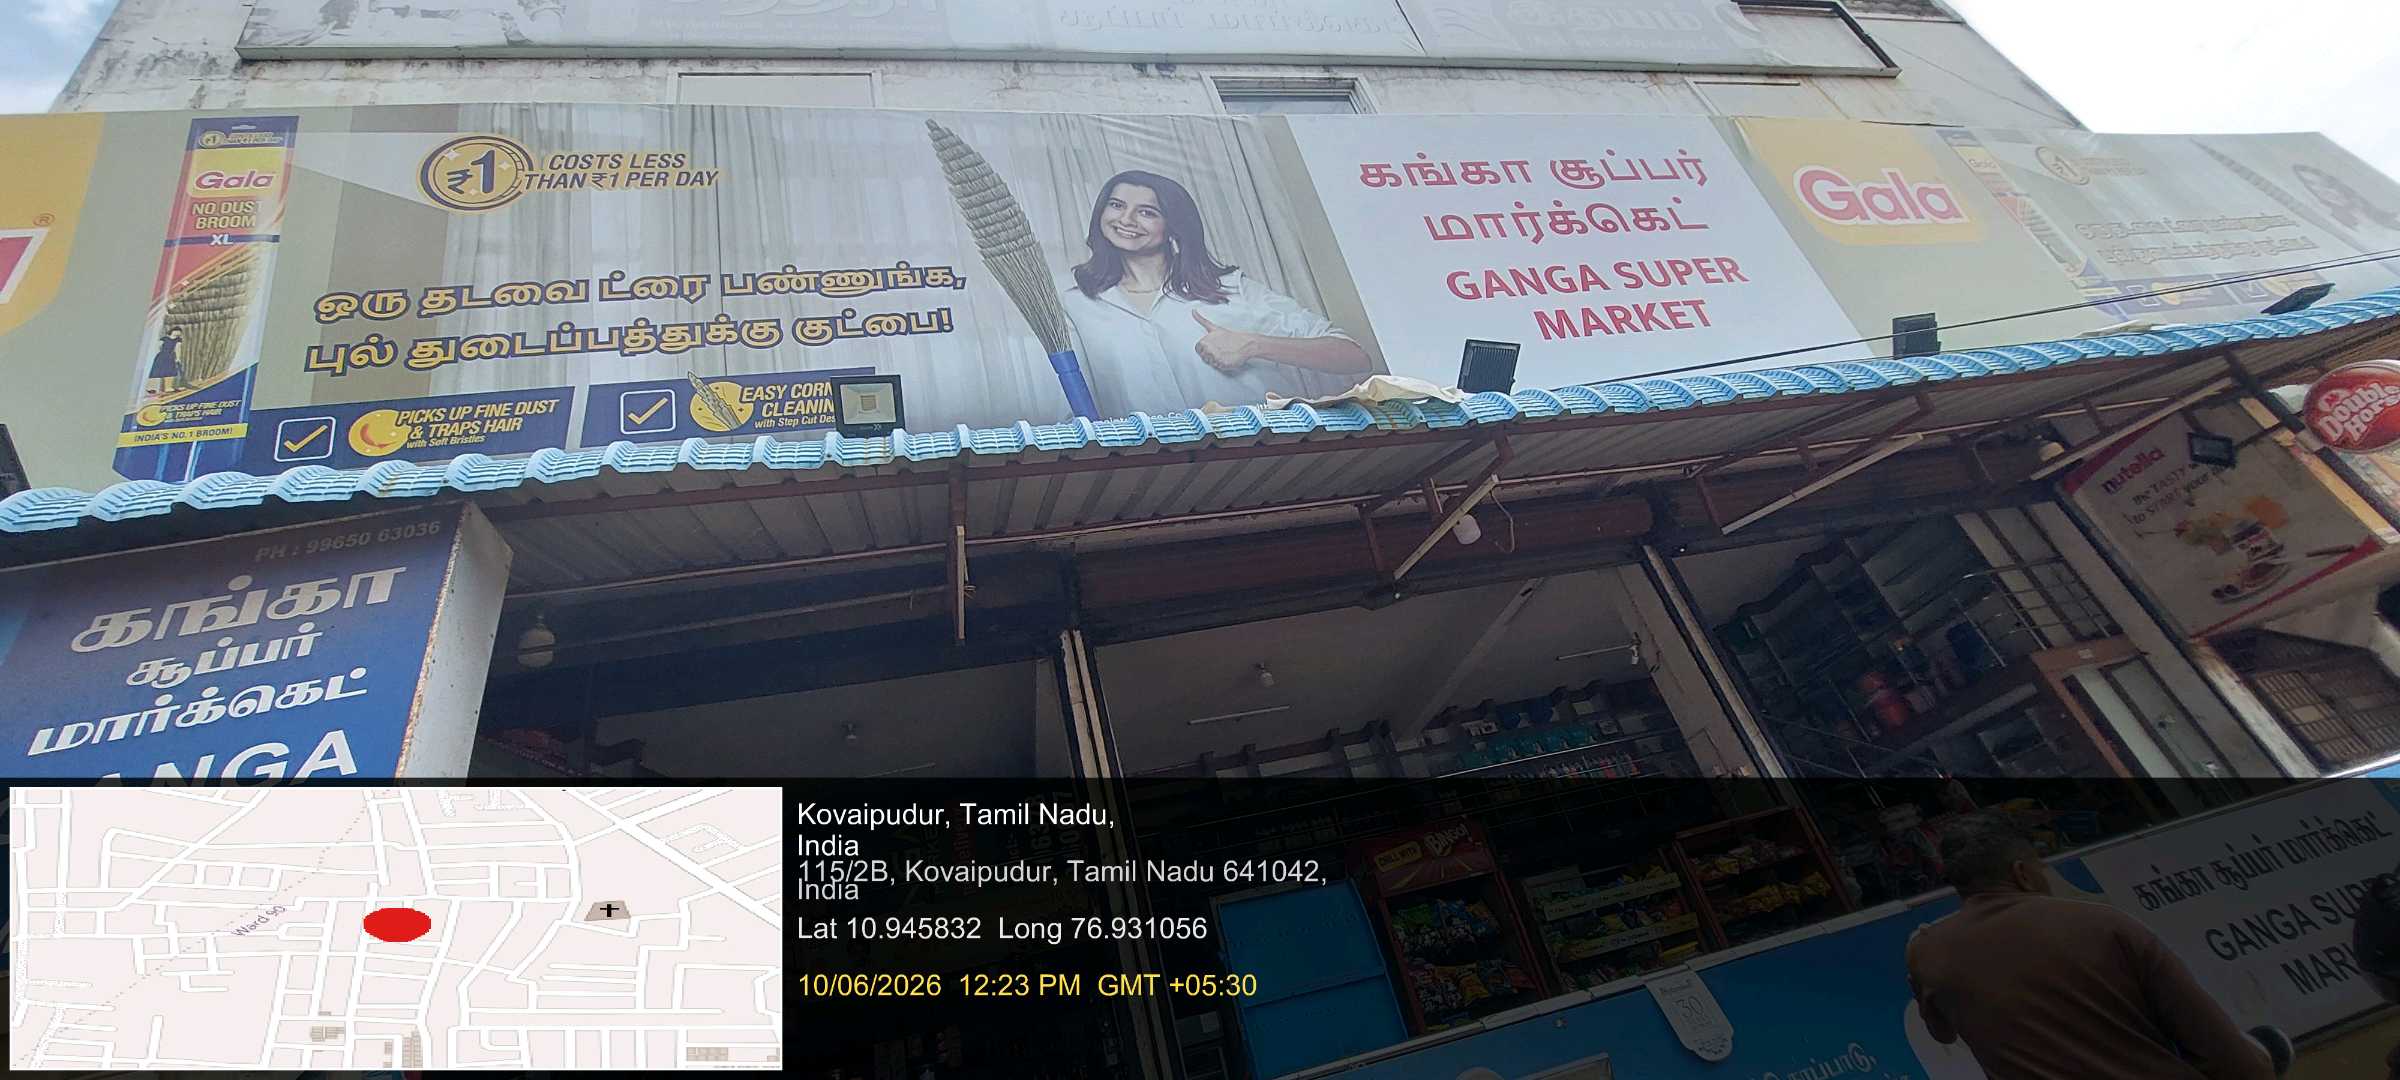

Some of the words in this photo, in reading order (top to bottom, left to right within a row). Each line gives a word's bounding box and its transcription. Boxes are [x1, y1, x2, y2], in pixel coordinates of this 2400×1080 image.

[195, 170, 276, 190] Gala
[447, 149, 496, 195] ₹1
[525, 172, 586, 190] THAN
[591, 171, 620, 189] ₹1
[624, 170, 669, 187] PER
[673, 169, 720, 187] DAY
[549, 153, 623, 171] COSTS
[628, 153, 686, 169] LESS
[1359, 151, 1534, 188] கங்கா
[1549, 148, 1709, 190] சூப்பர்
[192, 202, 216, 216] NO
[220, 200, 264, 214] DUST
[1796, 166, 1967, 225] Gala
[196, 215, 257, 230] BROOM
[210, 234, 234, 245] XL
[1423, 196, 1710, 245] மார்க்கெட்
[314, 289, 411, 325] ஒரு
[417, 278, 591, 319] தடவை
[598, 269, 711, 305] ட்ரை
[720, 260, 967, 298] பண்ணுங்க,
[1446, 264, 1613, 301] GANGA
[1613, 256, 1751, 290] SUPER
[1533, 298, 1713, 341] MARKET
[303, 332, 399, 378] புல்
[404, 313, 784, 371] துடைப்பத்துக்கு
[792, 307, 955, 347] குட்பை!
[397, 408, 446, 426] PICKS
[449, 406, 473, 421] UP
[474, 402, 514, 418] FINE
[514, 399, 561, 415] DUST
[742, 383, 788, 402] EASY
[134, 432, 169, 443] INDIA'S
[196, 427, 233, 438] BROOM!
[406, 439, 428, 449] with
[429, 437, 449, 448] Soft
[450, 434, 487, 446] Bristles
[410, 425, 423, 439] &
[428, 420, 481, 438] TRAPS
[483, 417, 524, 433] HAIR
[754, 418, 776, 429] with
[778, 416, 799, 429] Step
[801, 415, 818, 425] Cut
[256, 545, 288, 562] PH
[305, 531, 371, 555] 99650
[377, 521, 442, 544] 63036
[70, 566, 407, 655] கங்கா
[126, 622, 324, 690] சூப்பர்
[27, 667, 369, 757] மார்க்கெட்
[2133, 864, 2216, 911] கங்கா
[2205, 903, 2321, 961] GANGA
[2310, 873, 2400, 925] SUP
[1675, 995, 1704, 1019] 30
